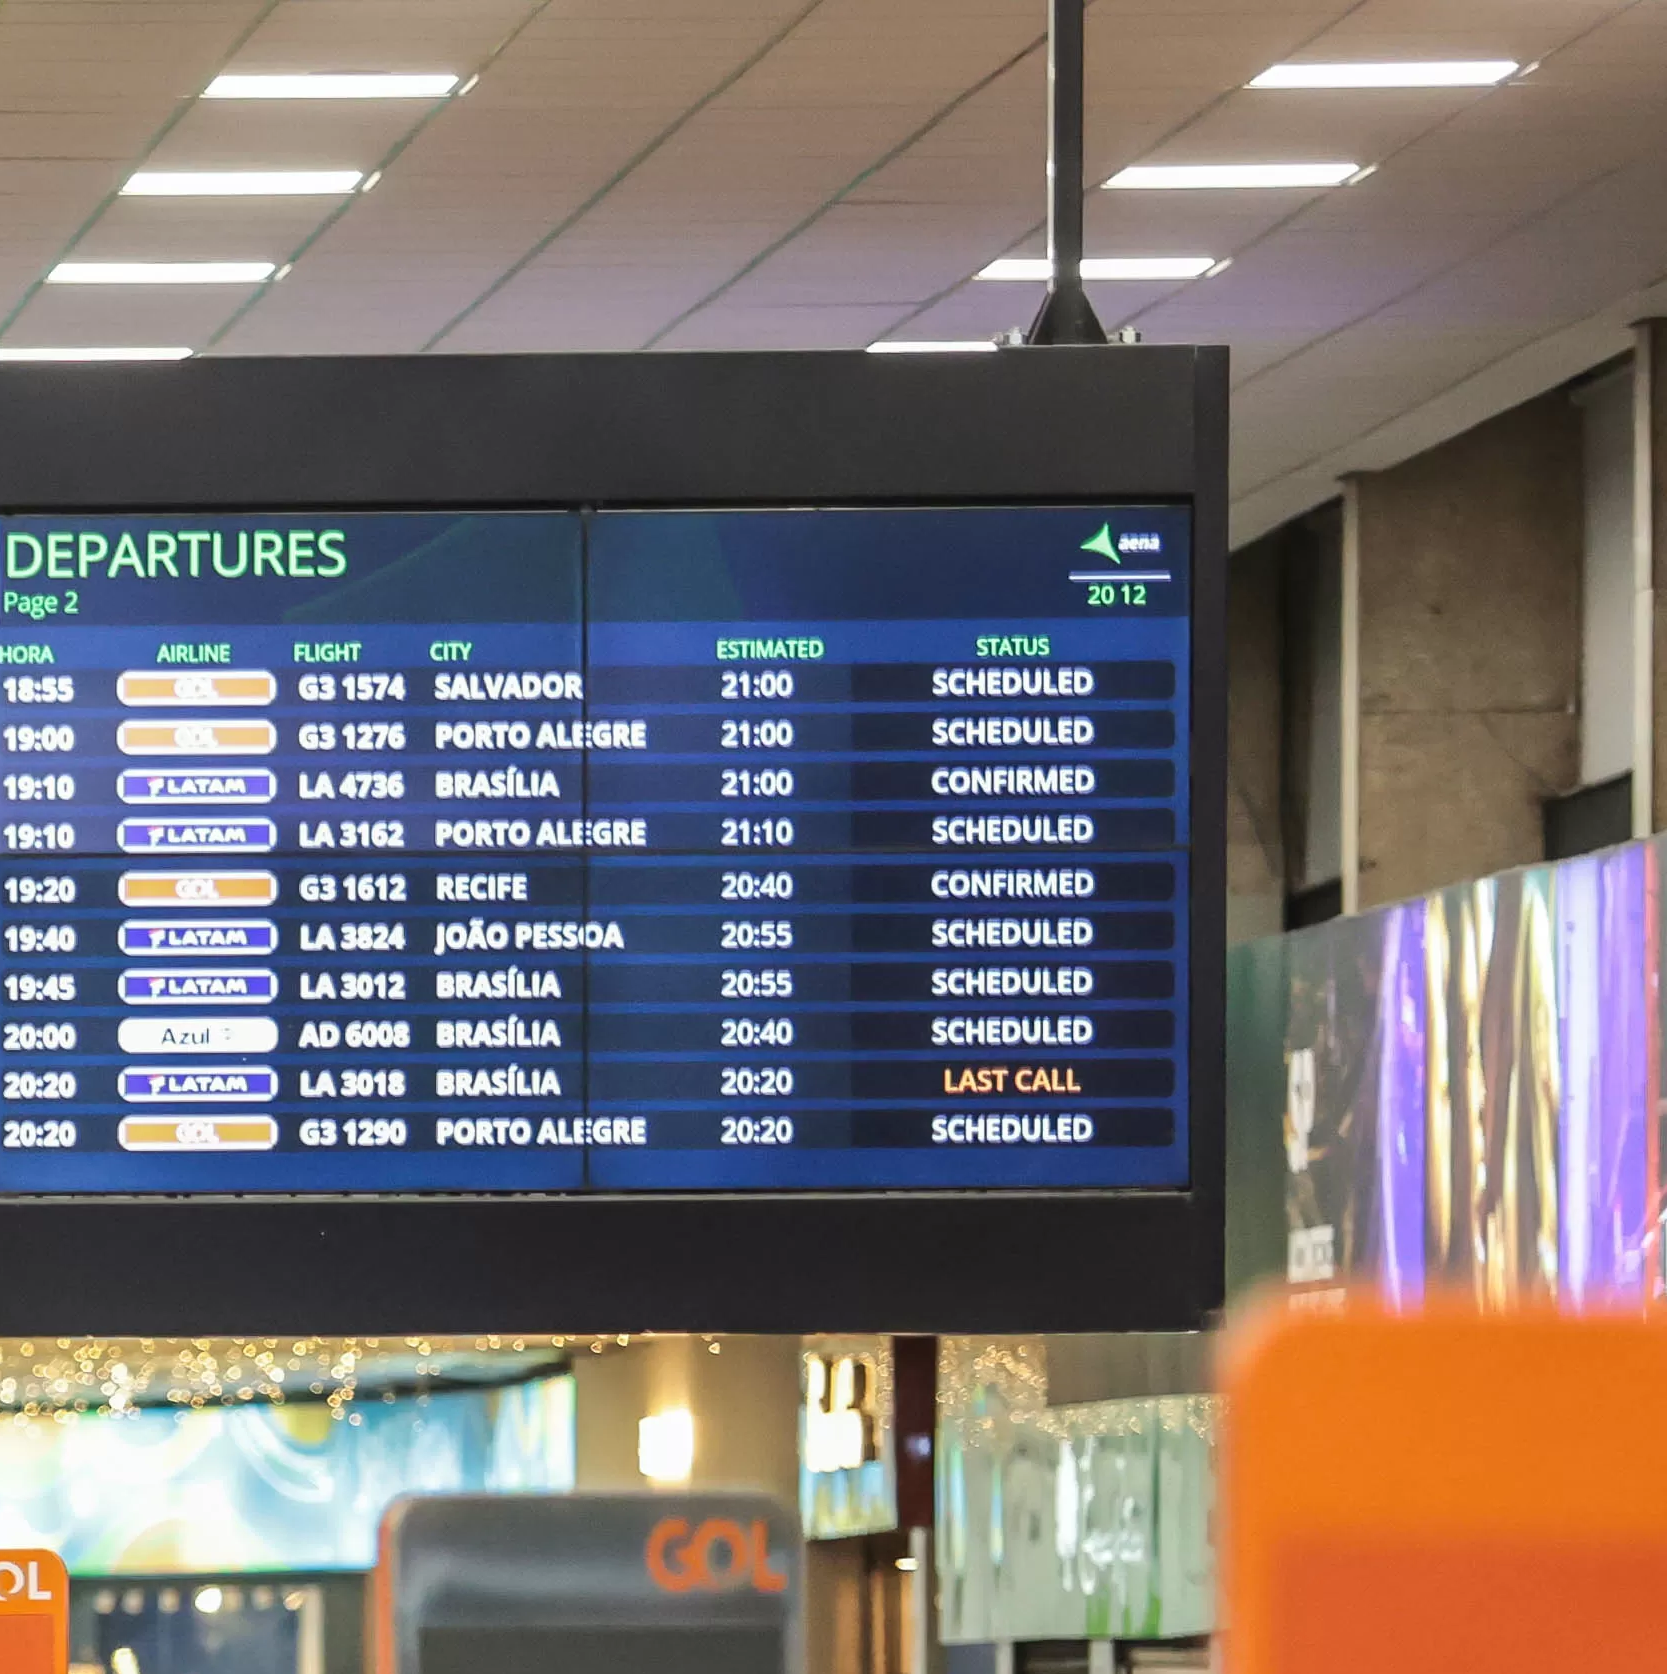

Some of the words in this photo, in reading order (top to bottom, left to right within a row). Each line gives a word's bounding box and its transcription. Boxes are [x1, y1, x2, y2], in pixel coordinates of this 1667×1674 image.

[7, 530, 347, 578] DEPARTURES
[4, 591, 59, 620] Page
[64, 590, 78, 614] 2
[1088, 585, 1114, 604] 20
[1121, 584, 1146, 604] 12
[157, 643, 231, 664] AIRLINE
[294, 641, 362, 663] FLIGHT
[430, 640, 472, 661] CITY
[717, 637, 824, 660] ESTIMATED
[977, 635, 1050, 656] STATUS
[3, 676, 74, 703] 18:55
[299, 674, 336, 700] G3
[342, 674, 405, 700] 1574
[435, 673, 583, 700] SALVADOR
[722, 671, 793, 698] 21:00
[933, 669, 1093, 695] SCHEDULED
[3, 725, 75, 751] 19:00
[299, 724, 336, 750] G3
[342, 723, 406, 749] 1276
[436, 722, 531, 749] PORTO
[536, 721, 646, 748] ALEGRE
[722, 720, 793, 747] 21:00
[933, 718, 1093, 745] SCHEDULED
[3, 774, 75, 800] 19:10
[167, 778, 247, 795] LATAM
[299, 772, 335, 798] LA
[339, 772, 404, 798] 4736
[436, 766, 560, 798] BRASÍLIA
[722, 770, 793, 795] 21:00
[932, 767, 1094, 794] CONFIRMED
[4, 823, 75, 849] 19:10
[167, 826, 247, 843] LATAM
[300, 822, 335, 848] LA
[340, 821, 404, 847] 3162
[435, 821, 530, 847] PORTO
[536, 820, 646, 846] ALEGRE
[722, 819, 793, 845] 21:10
[933, 816, 1093, 843] SCHEDULED
[5, 877, 75, 903] 19:20
[299, 875, 336, 900] G3
[343, 875, 406, 900] 1612
[437, 874, 527, 900] RECIFE
[722, 873, 792, 898] 20:40
[932, 871, 1093, 896] CONFIRMED
[5, 926, 76, 952] 19:40
[167, 929, 247, 945] LATAM
[301, 925, 336, 950] LA
[341, 924, 405, 950] 3824
[434, 918, 508, 955] JOÃO
[516, 922, 624, 949] PESSOA
[722, 922, 792, 948] 20:55
[932, 920, 1092, 946] SCHEDULED
[5, 975, 75, 1000] 19:45
[167, 978, 247, 995] LATAM
[301, 973, 336, 999] LA
[341, 973, 405, 999] 3012
[437, 966, 561, 998] BRASÍLIA
[722, 971, 792, 996] 20:55
[932, 969, 1092, 994] SCHEDULED
[4, 1023, 76, 1050] 20:00
[163, 1027, 209, 1045] Azul
[299, 1022, 340, 1047] AD
[345, 1021, 410, 1047] 6008
[437, 1015, 561, 1047] BRASÍLIA
[721, 1019, 793, 1045] 20:40
[932, 1018, 1092, 1044] SCHEDULED
[4, 1072, 76, 1098] 20:20
[167, 1076, 247, 1092] LATAM
[300, 1071, 336, 1097] LA
[341, 1070, 405, 1096] 3018
[436, 1064, 560, 1096] BRASÍLIA
[721, 1068, 793, 1095] 20:20
[945, 1069, 1008, 1093] LAST
[1015, 1069, 1080, 1091] CALL
[4, 1121, 76, 1147] 20:20
[300, 1119, 337, 1145] G3
[343, 1119, 406, 1145] 1290
[437, 1119, 531, 1145] PORTO
[537, 1117, 646, 1144] ALEGRE
[721, 1117, 792, 1143] 20:20
[932, 1116, 1092, 1141] SCHEDULED
[646, 1516, 786, 1594] GOL
